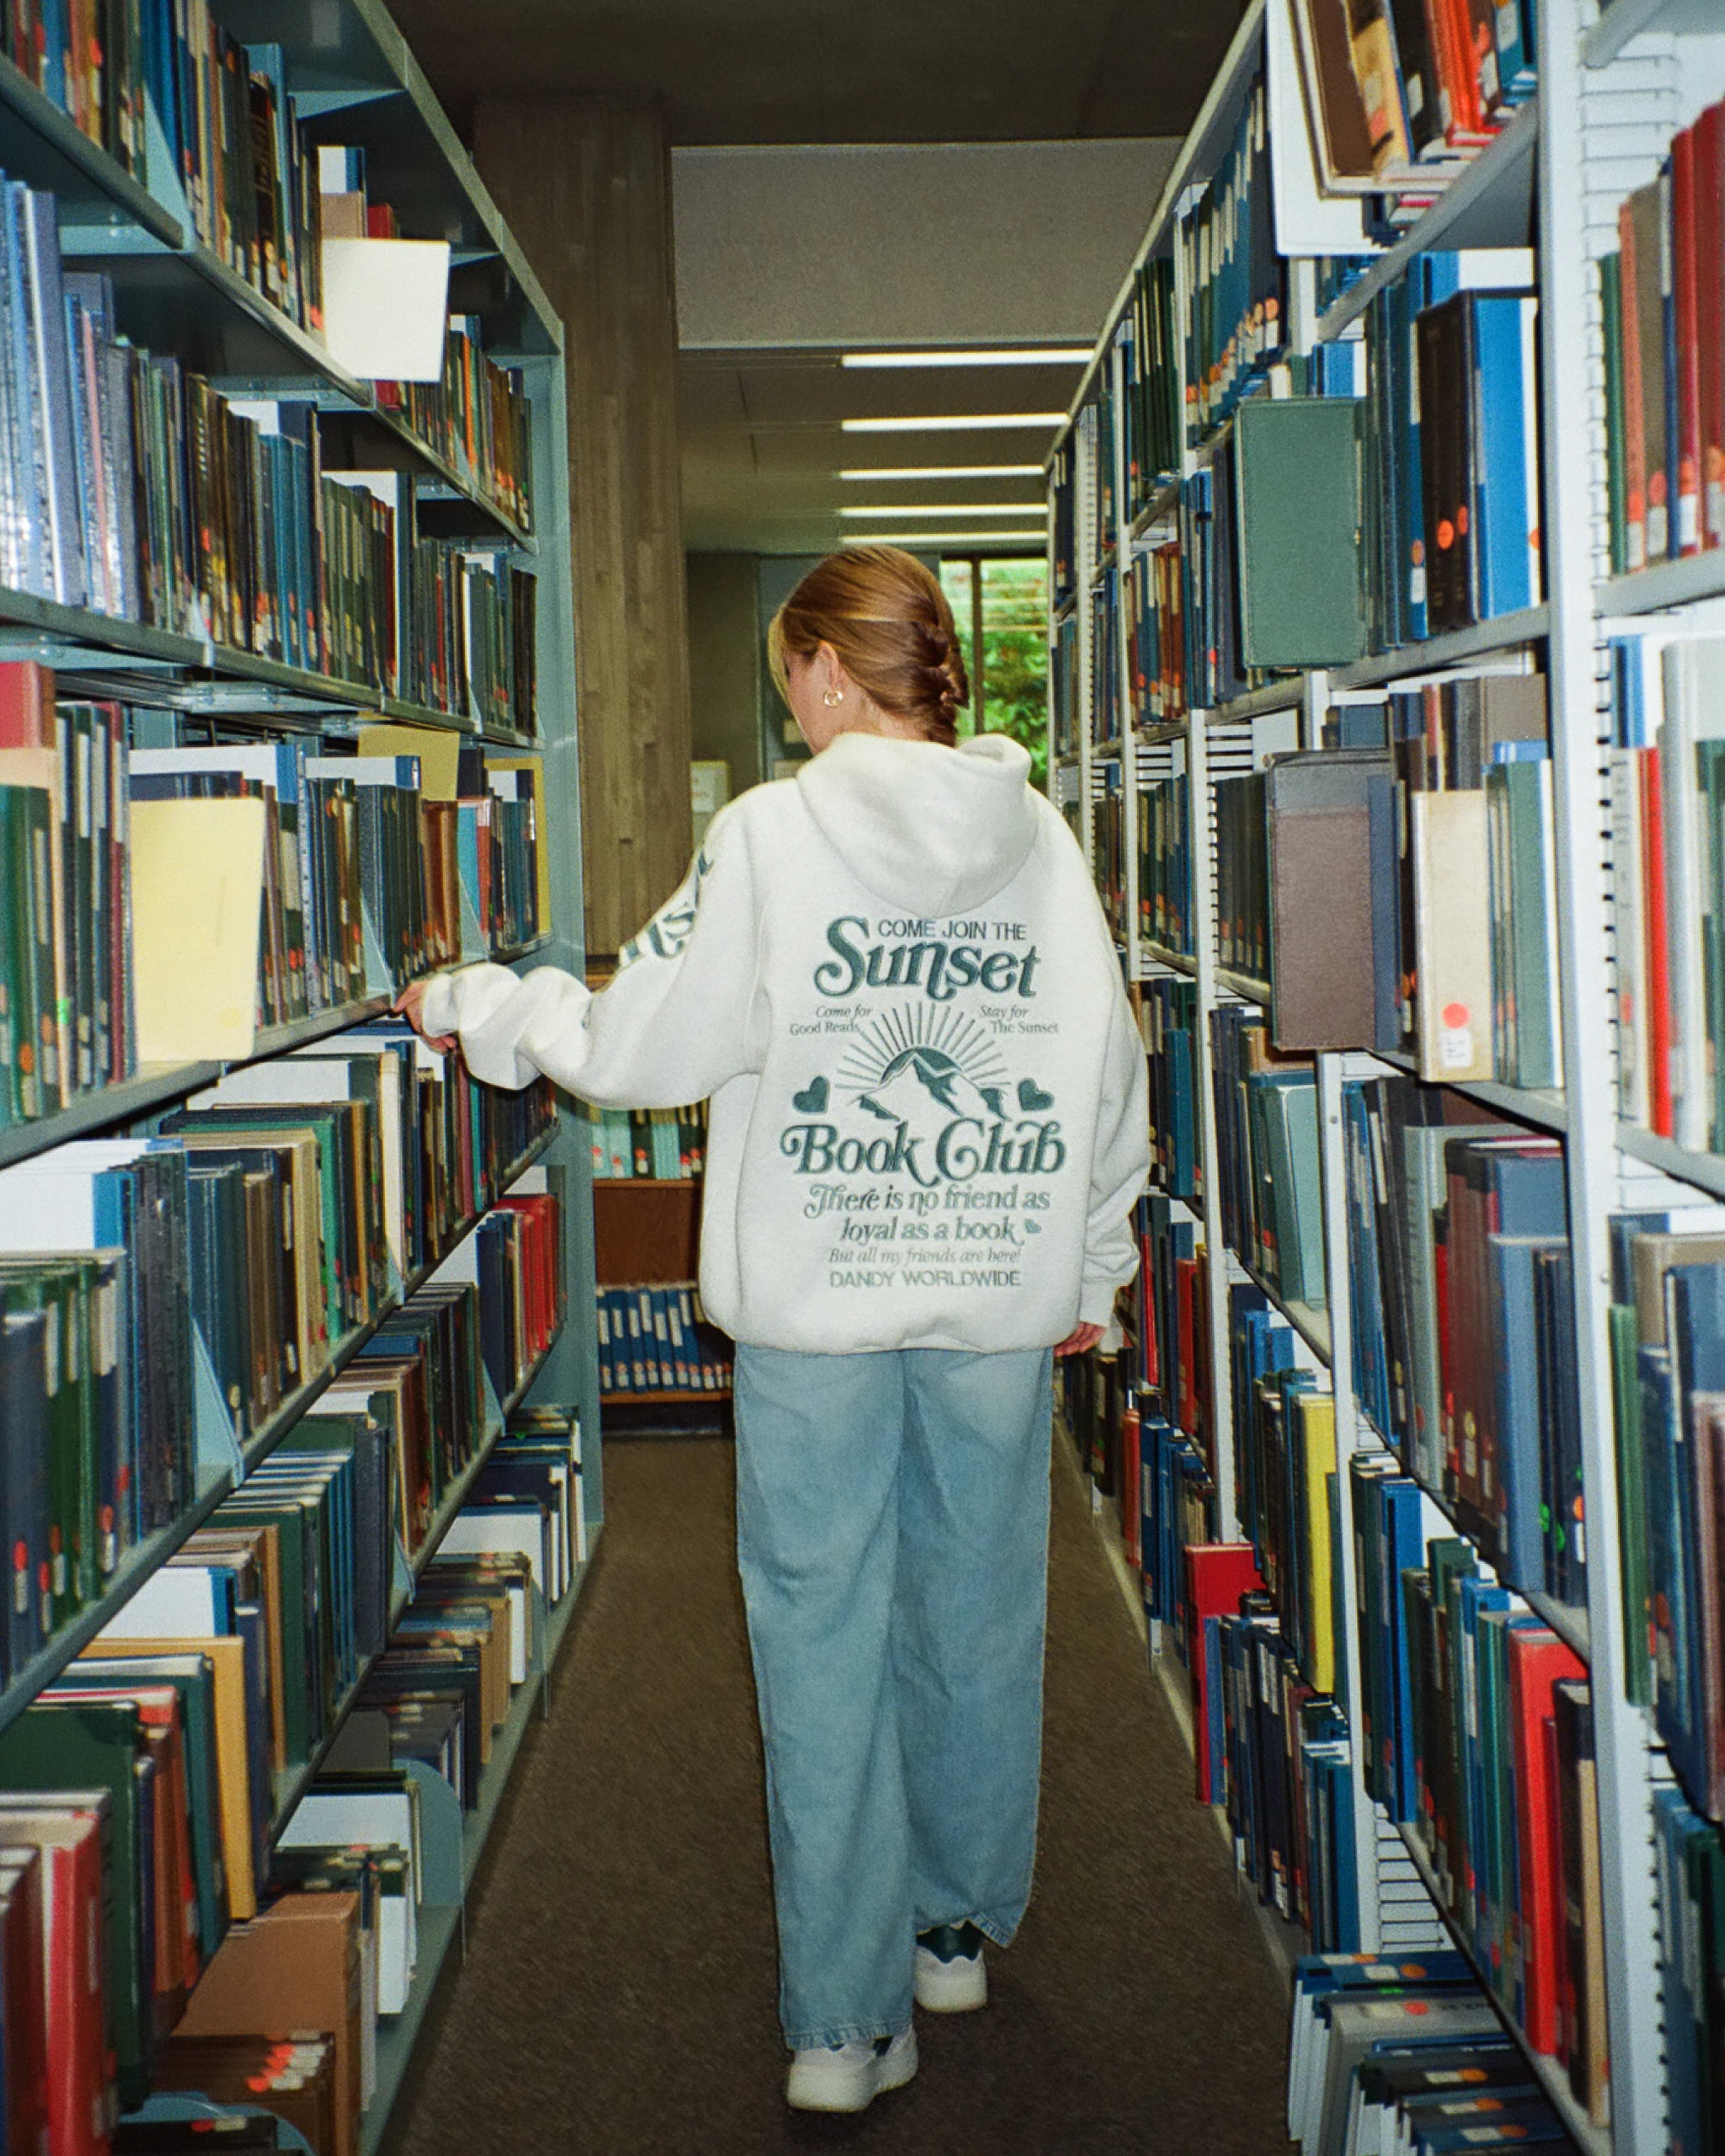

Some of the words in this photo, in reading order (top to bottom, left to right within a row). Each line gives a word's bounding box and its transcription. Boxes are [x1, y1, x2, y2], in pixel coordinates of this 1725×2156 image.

[878, 919, 936, 938] COME
[942, 921, 987, 939] JOIN
[992, 921, 1027, 941] THE
[814, 915, 1041, 1001] Sunset
[814, 1005, 852, 1018] Come
[852, 1003, 873, 1022] for
[979, 1005, 1009, 1020] Stay
[1009, 1004, 1028, 1022] for
[789, 1021, 821, 1035] Good
[824, 1020, 860, 1033] Reads
[990, 1020, 1014, 1033] The
[1017, 1022, 1059, 1034] Sunset
[780, 1120, 941, 1187] Book
[936, 1118, 1066, 1181] Club
[803, 1183, 880, 1219] There
[884, 1184, 904, 1210] is
[908, 1191, 939, 1216] no
[943, 1183, 1018, 1210] friend
[1022, 1191, 1050, 1210] as
[840, 1215, 899, 1246] loyal
[900, 1223, 929, 1240] as
[933, 1223, 949, 1240] a
[955, 1215, 1025, 1246] book
[829, 1248, 854, 1262] But
[857, 1246, 877, 1262] all
[880, 1251, 904, 1267] my
[905, 1246, 956, 1267] friends
[960, 1251, 985, 1262] are
[987, 1246, 1022, 1263] here!
[830, 1270, 895, 1288] DANDY
[900, 1270, 1022, 1287] WORLDWIDE
